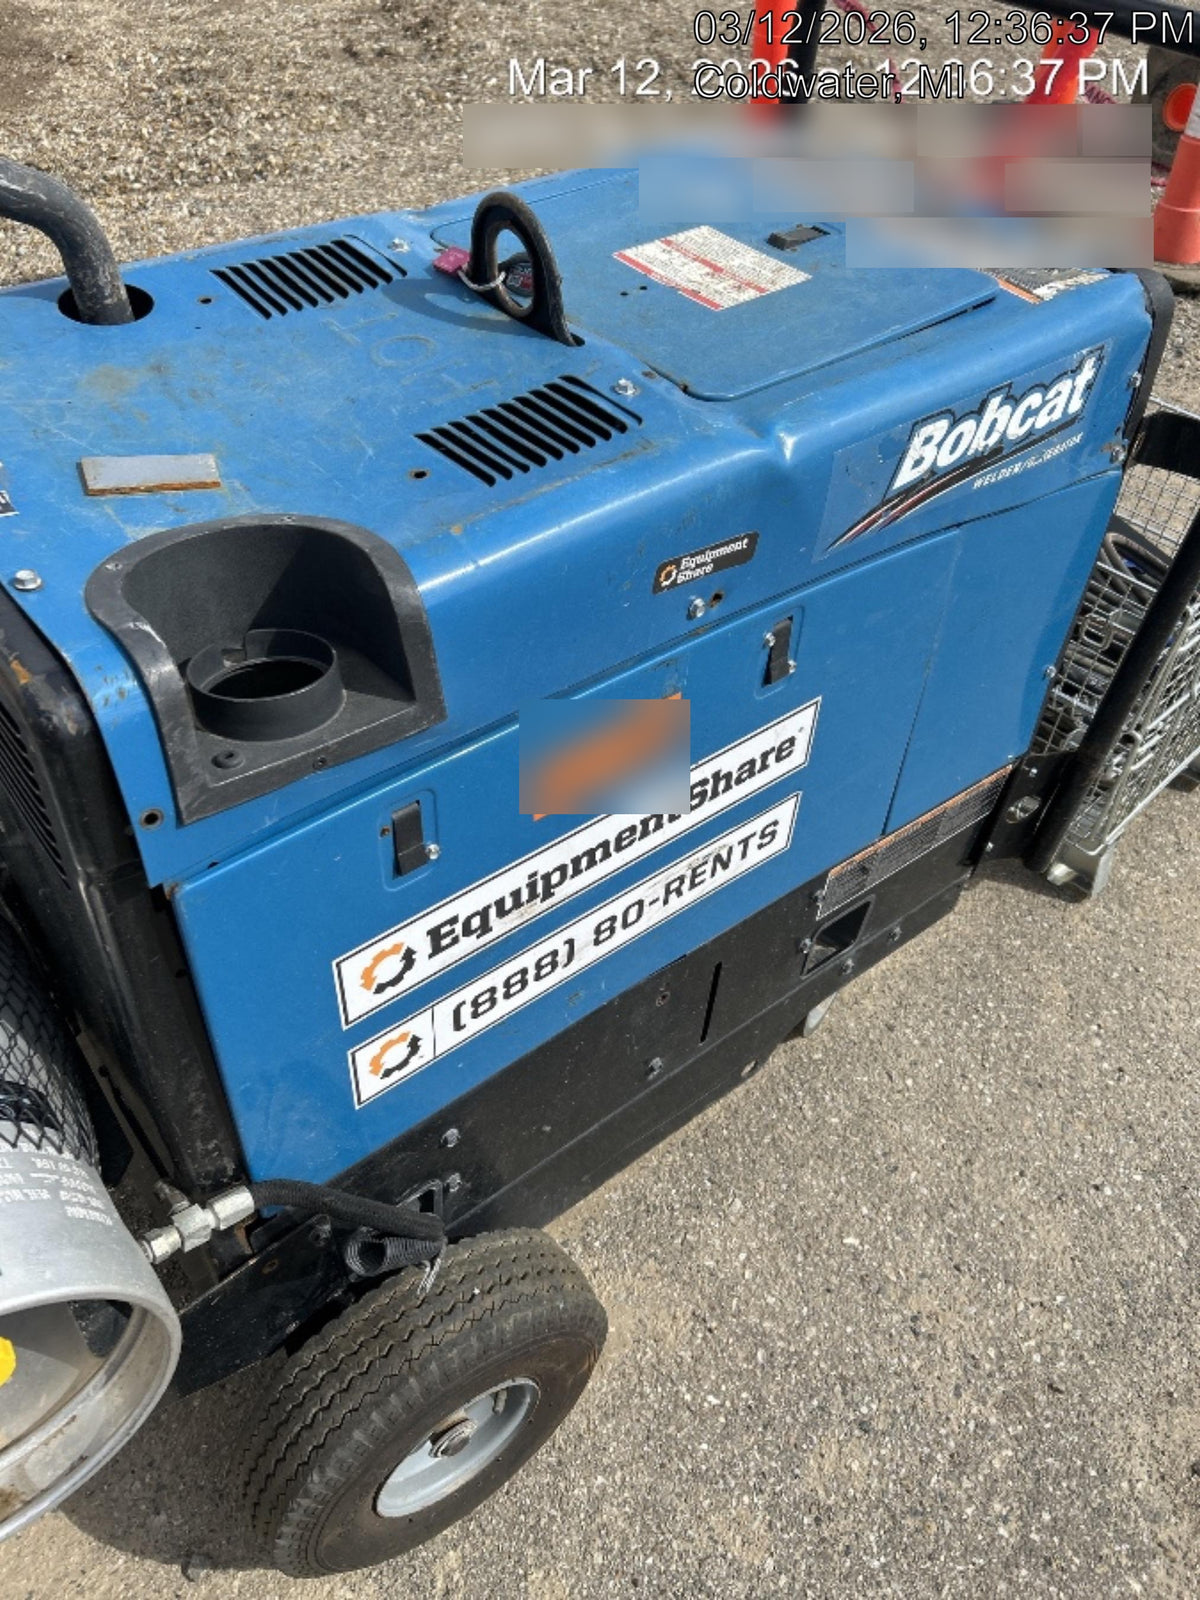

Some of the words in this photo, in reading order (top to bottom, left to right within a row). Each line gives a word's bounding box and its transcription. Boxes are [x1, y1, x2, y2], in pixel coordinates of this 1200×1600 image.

[891, 354, 1098, 490] Bobcat
[451, 937, 577, 1033] (888)
[592, 818, 780, 947] 80-RENTS
